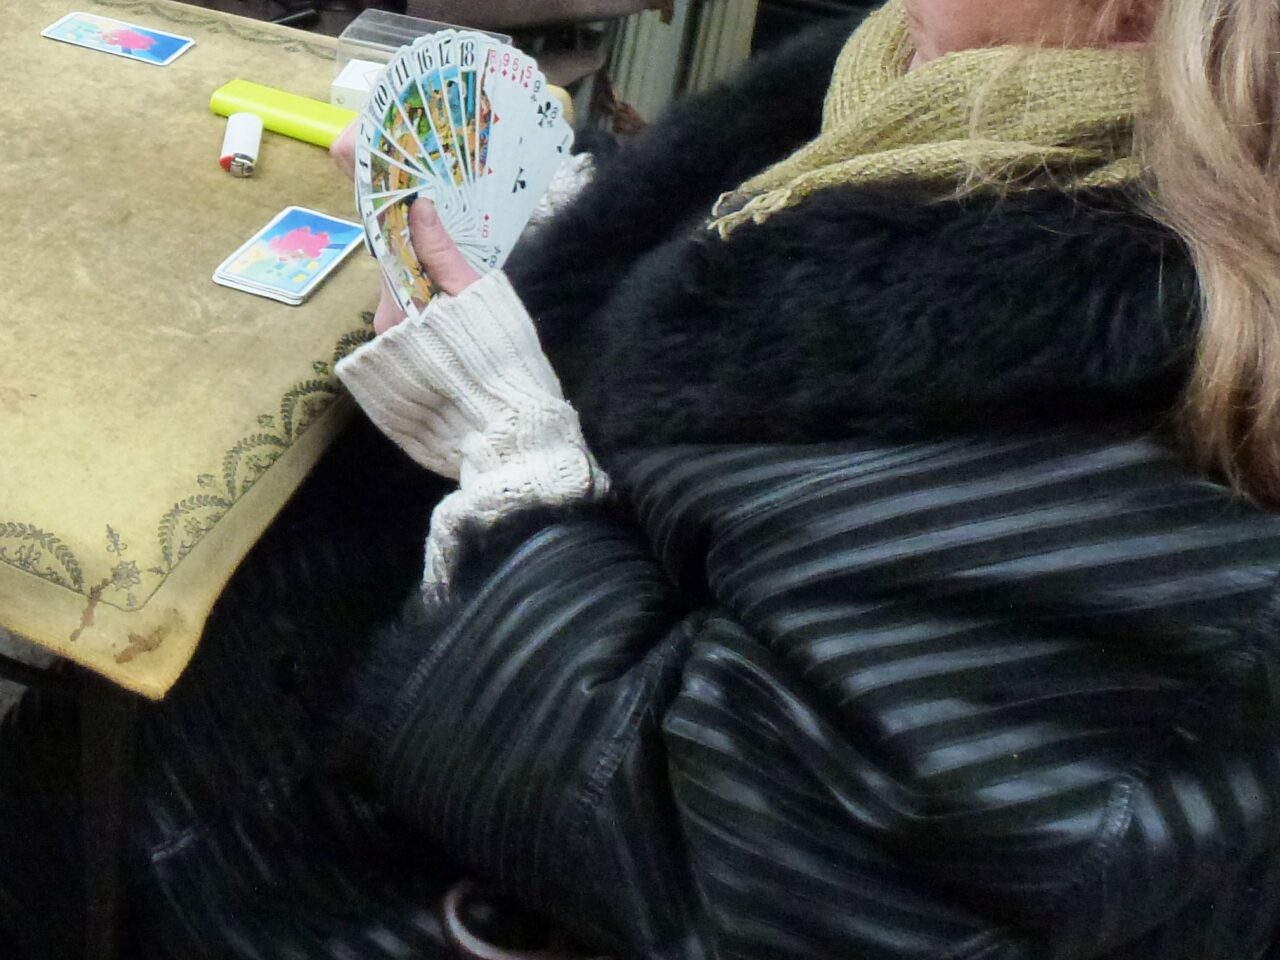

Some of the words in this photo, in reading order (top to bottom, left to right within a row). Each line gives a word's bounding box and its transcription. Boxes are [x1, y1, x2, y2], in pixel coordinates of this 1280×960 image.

[417, 48, 433, 76] 16
[438, 39, 452, 67] 17
[460, 42, 475, 67] 18
[503, 53, 511, 67] 9
[395, 57, 410, 86] 11
[526, 66, 533, 79] 5
[374, 84, 389, 113] 10
